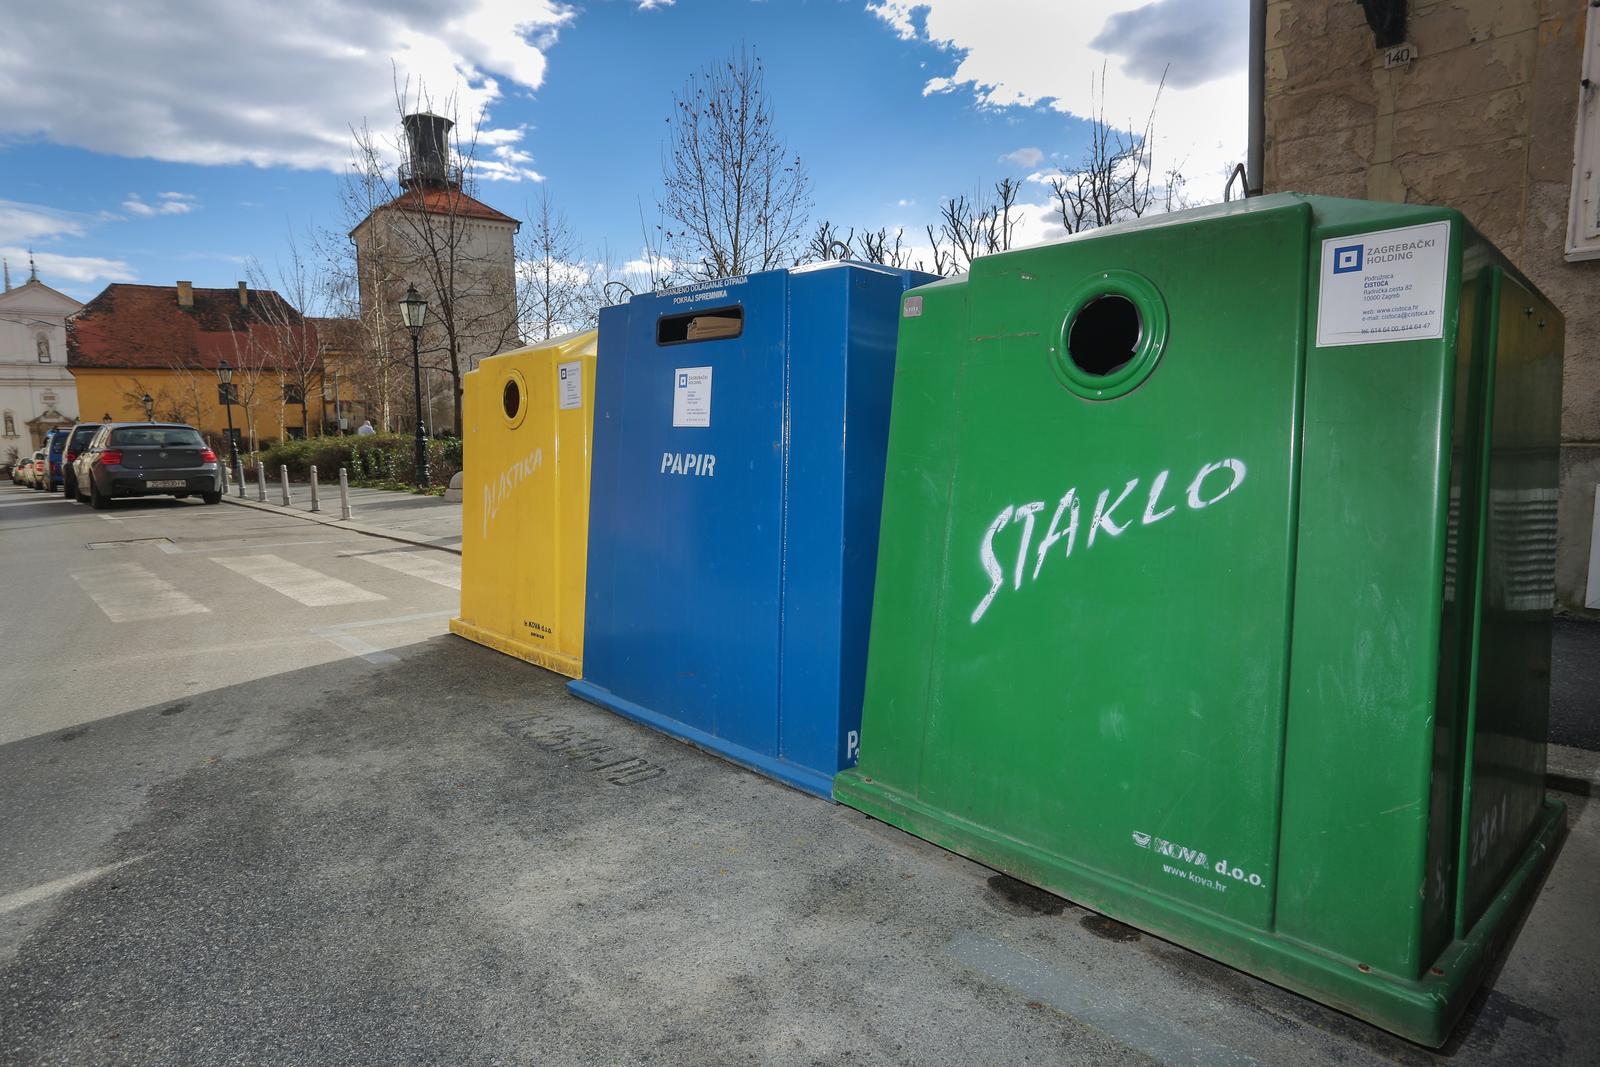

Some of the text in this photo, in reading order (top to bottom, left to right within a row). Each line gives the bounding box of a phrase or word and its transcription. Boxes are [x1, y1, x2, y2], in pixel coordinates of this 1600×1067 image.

[1385, 49, 1410, 65] 140
[1366, 252, 1413, 264] HOLDING
[1367, 240, 1435, 256] ZAGREBAČKI
[656, 276, 748, 298] ZABRANJENO ODLAGANJE OTPADA
[673, 290, 728, 305] POKRAJ SPREMNIKA
[660, 452, 716, 477] PAPIR
[483, 447, 543, 540] PLASTIKA
[970, 457, 1247, 625] STAKLO
[1154, 837, 1266, 888] KOVA d.o.o.
[1163, 863, 1227, 892] www.kova.hr
